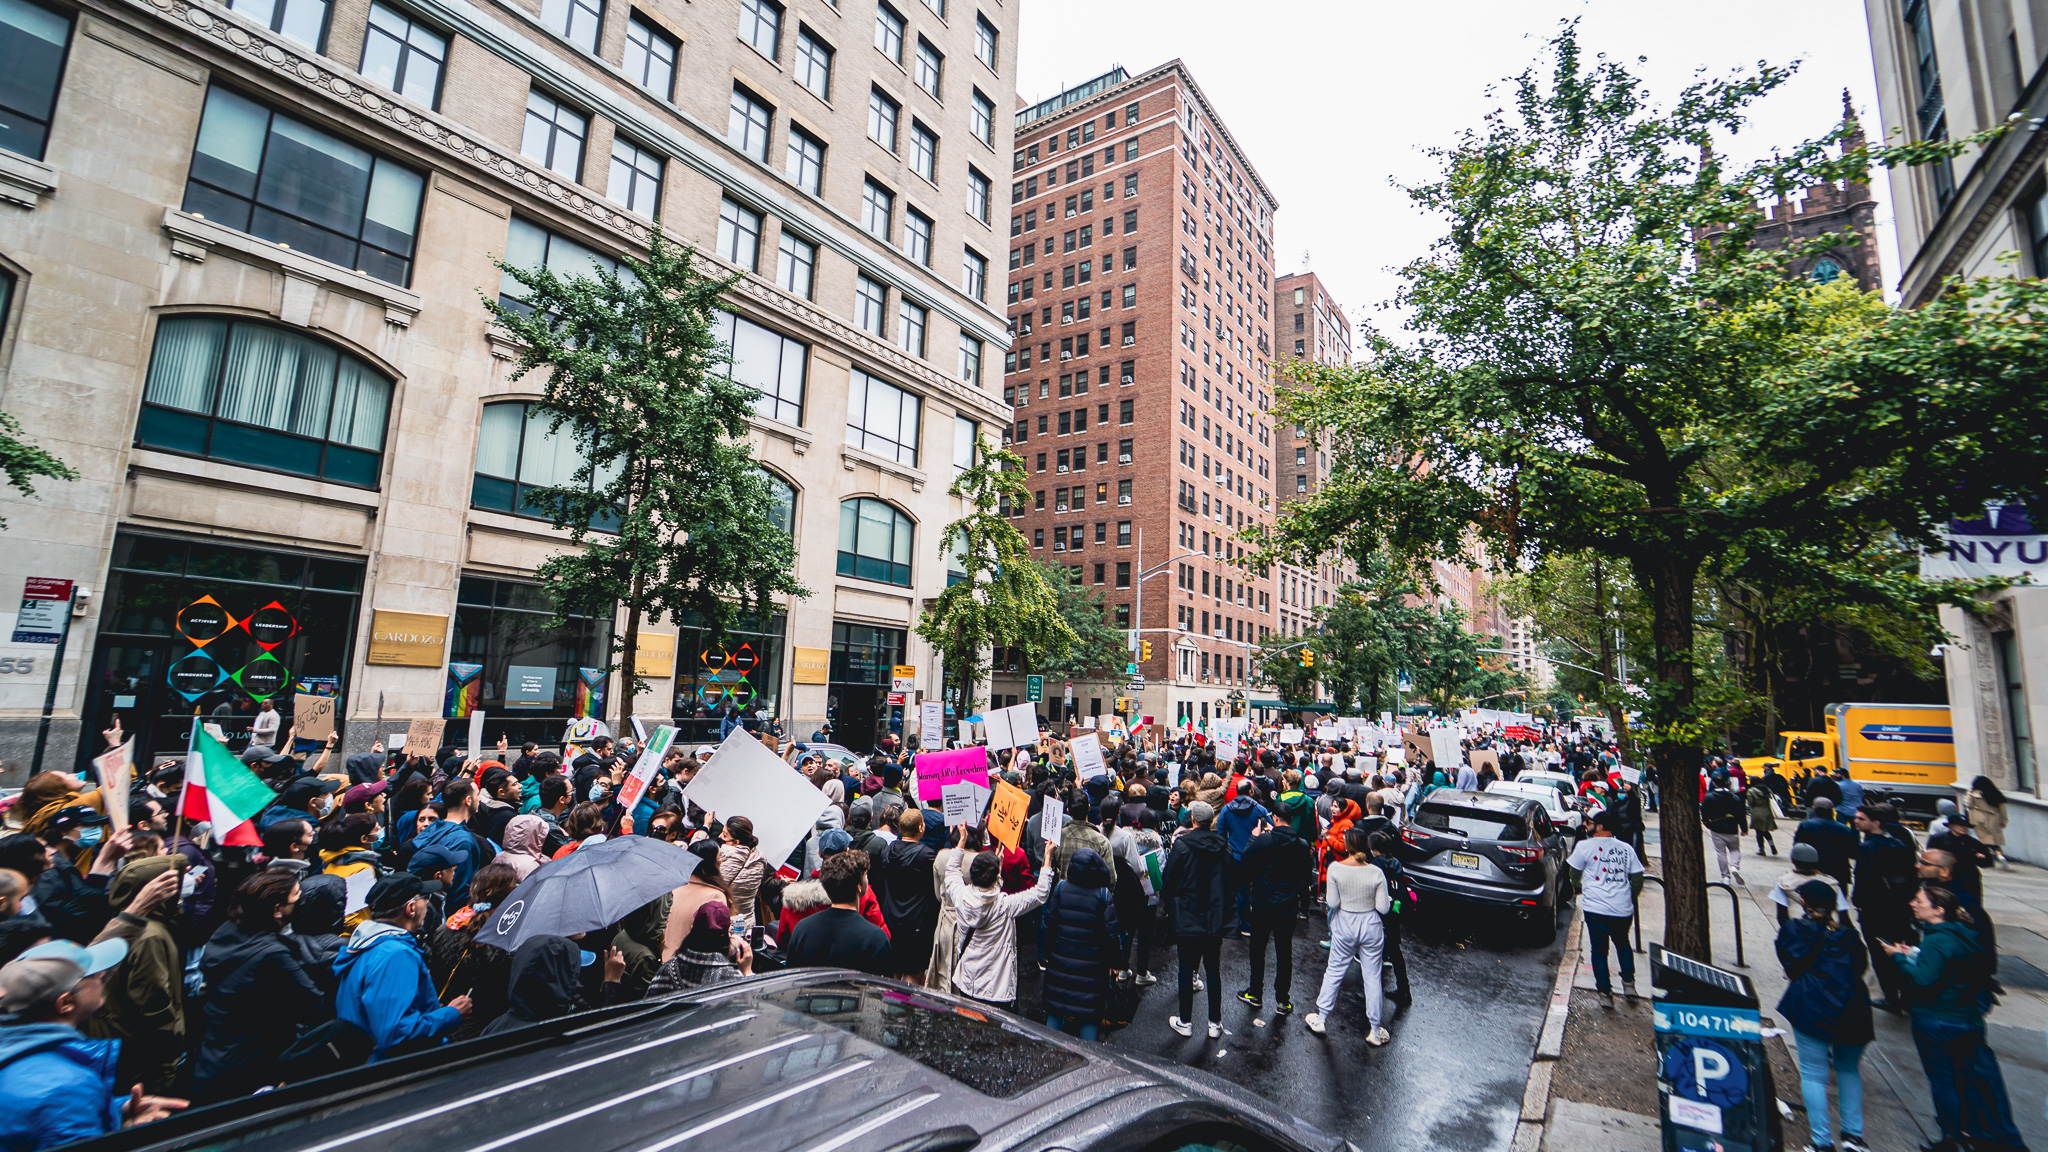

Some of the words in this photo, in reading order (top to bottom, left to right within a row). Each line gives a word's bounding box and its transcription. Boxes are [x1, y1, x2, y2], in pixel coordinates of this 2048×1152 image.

[1949, 540, 2048, 564] NYU
[25, 600, 33, 608] 2
[255, 622, 289, 630] LEADERSHIP
[373, 630, 445, 646] CARDOZO
[636, 649, 673, 661] ARDOZO
[795, 661, 828, 670] CARDOZO
[318, 700, 332, 715] زن
[955, 763, 988, 776] Freedom
[1693, 1047, 1731, 1097] P
